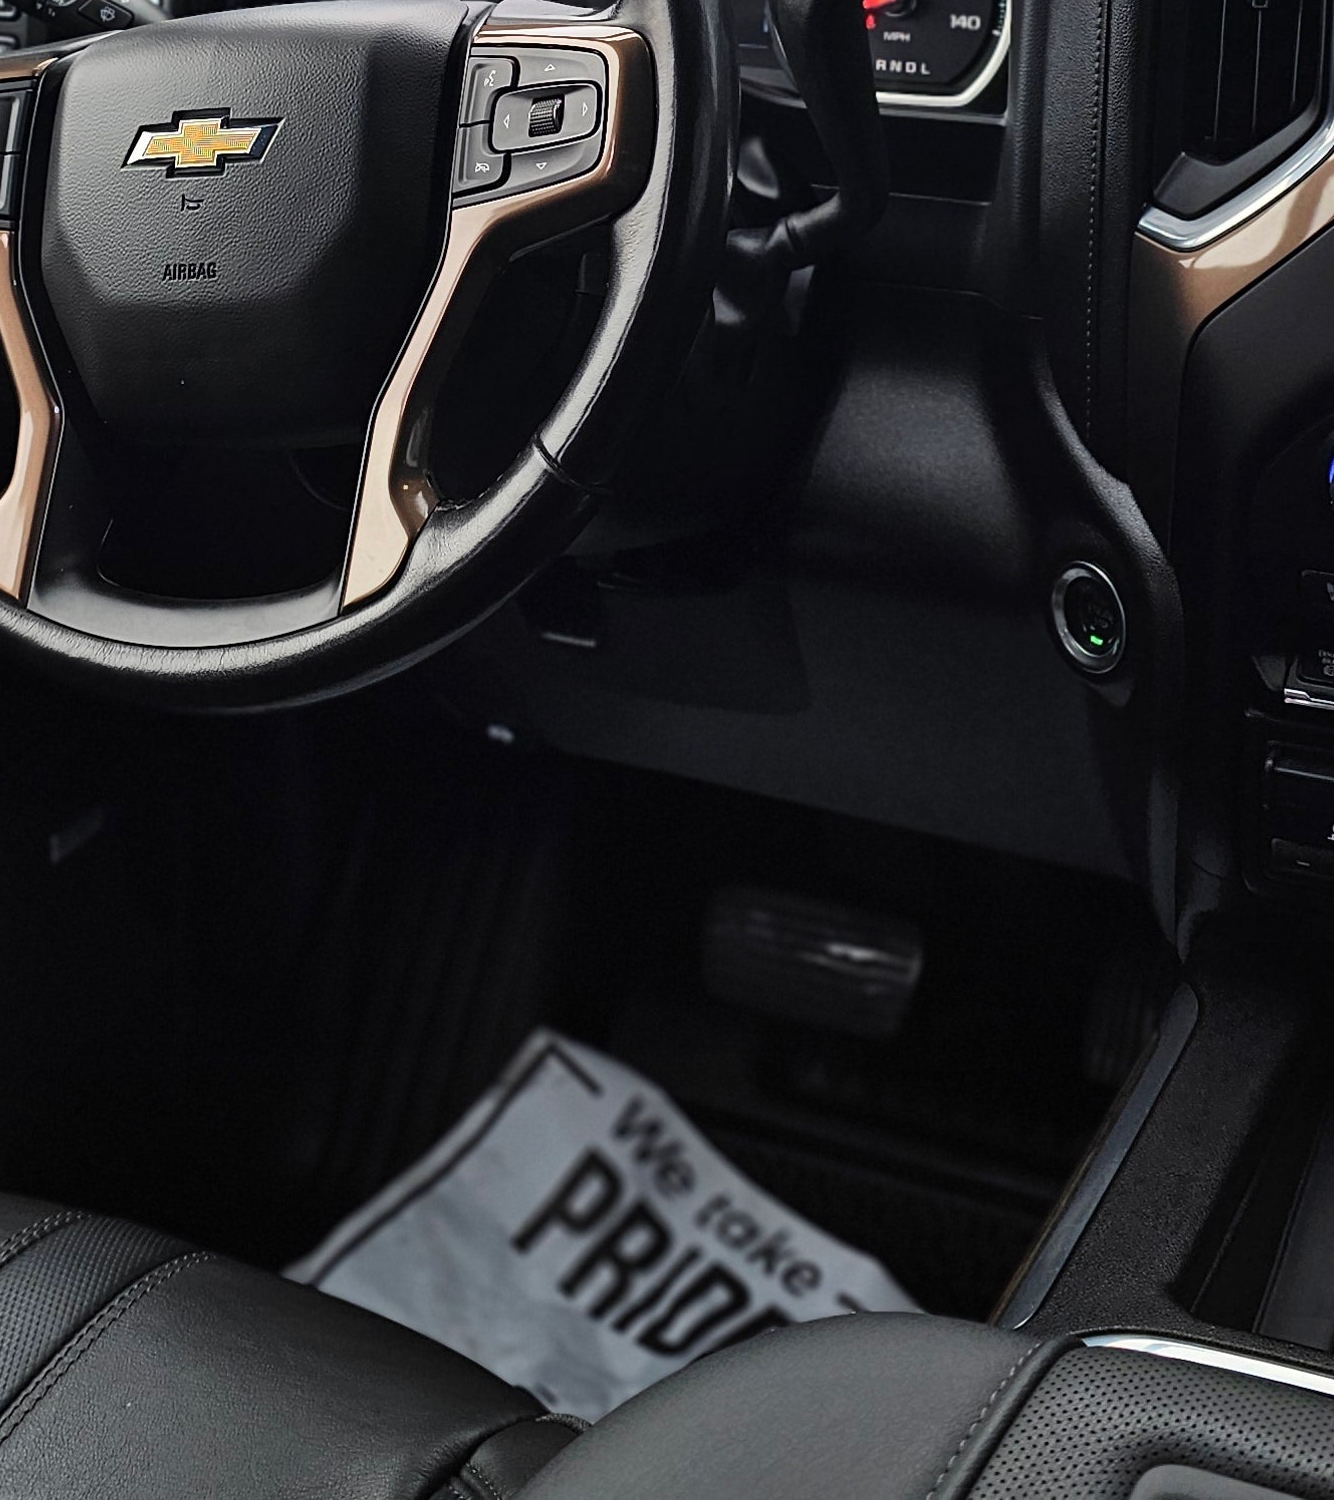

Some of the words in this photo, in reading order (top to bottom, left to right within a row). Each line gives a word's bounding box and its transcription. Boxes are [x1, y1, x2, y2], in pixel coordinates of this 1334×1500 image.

[949, 13, 982, 31] 140
[883, 31, 911, 42] MPH
[162, 262, 217, 281] AIRBAG
[611, 1094, 696, 1195] We
[694, 1194, 824, 1298] take
